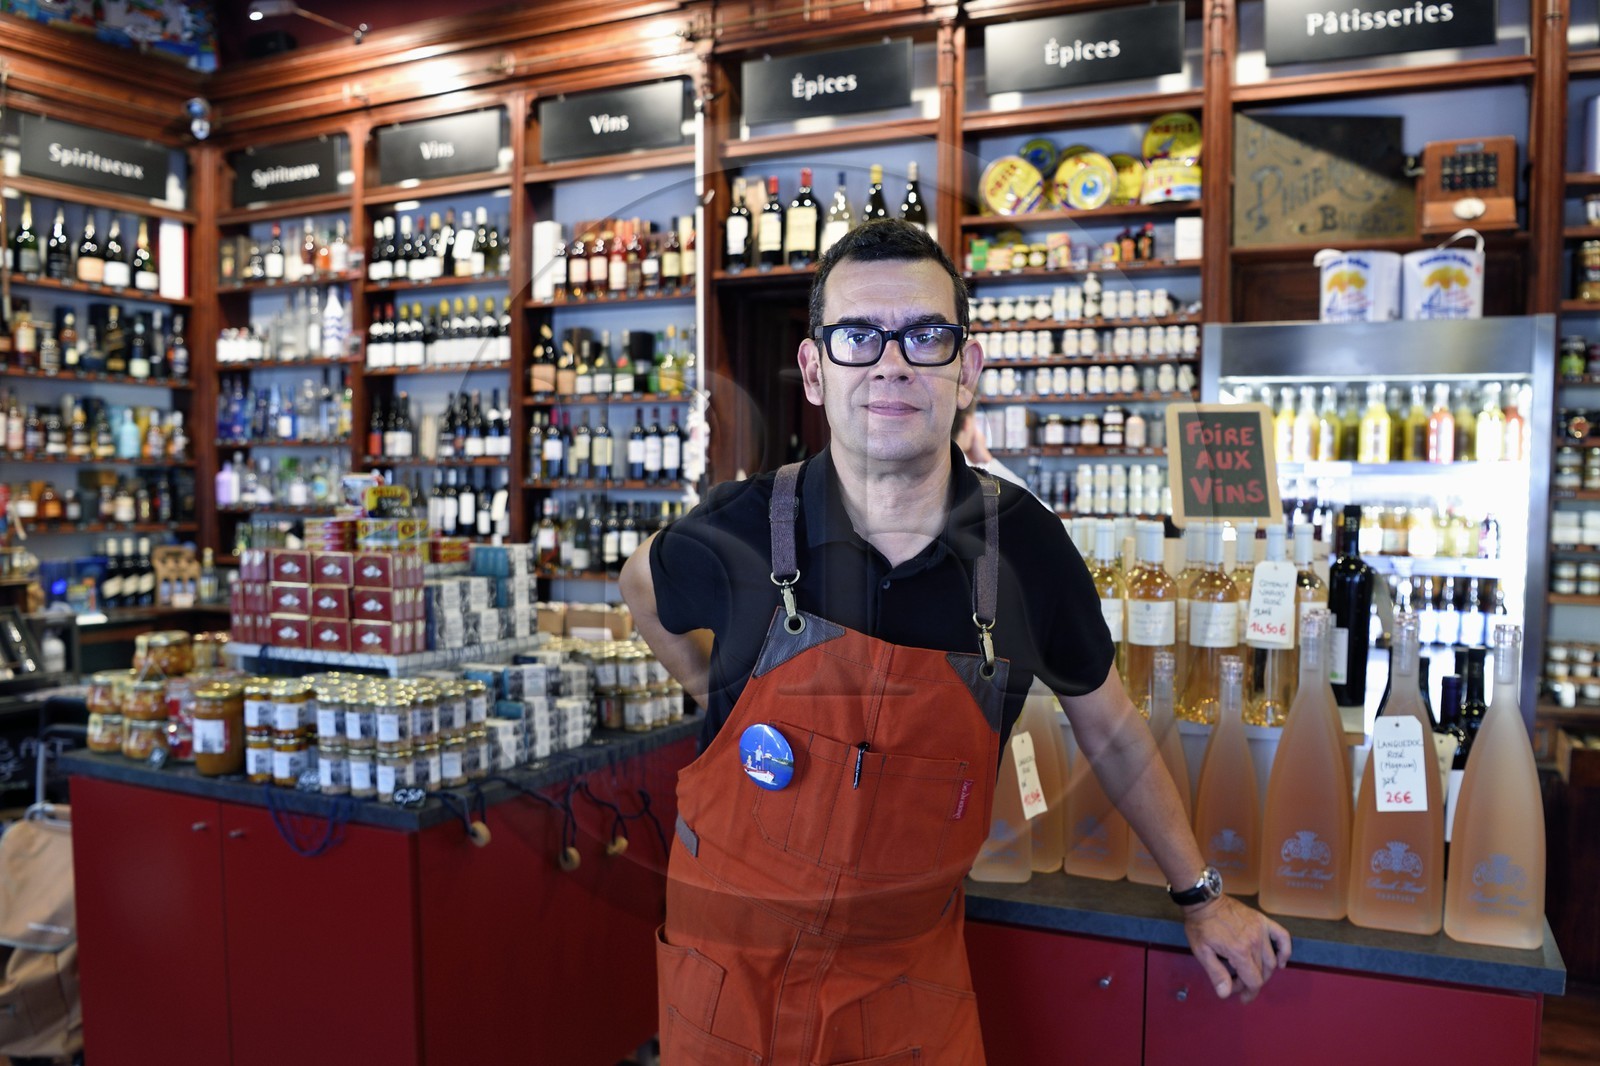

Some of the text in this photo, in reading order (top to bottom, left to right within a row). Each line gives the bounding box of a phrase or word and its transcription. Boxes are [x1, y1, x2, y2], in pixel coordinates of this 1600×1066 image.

[1306, 1, 1454, 36] Pâtisseries
[1044, 38, 1120, 68] Épices
[791, 72, 857, 100] Épices
[589, 114, 629, 134] Vins
[48, 142, 144, 180] Spiritueux
[419, 141, 455, 160] Vins
[251, 163, 320, 189] Spiritueux
[1195, 450, 1252, 470] AUX
[1386, 790, 1413, 804] 26€
